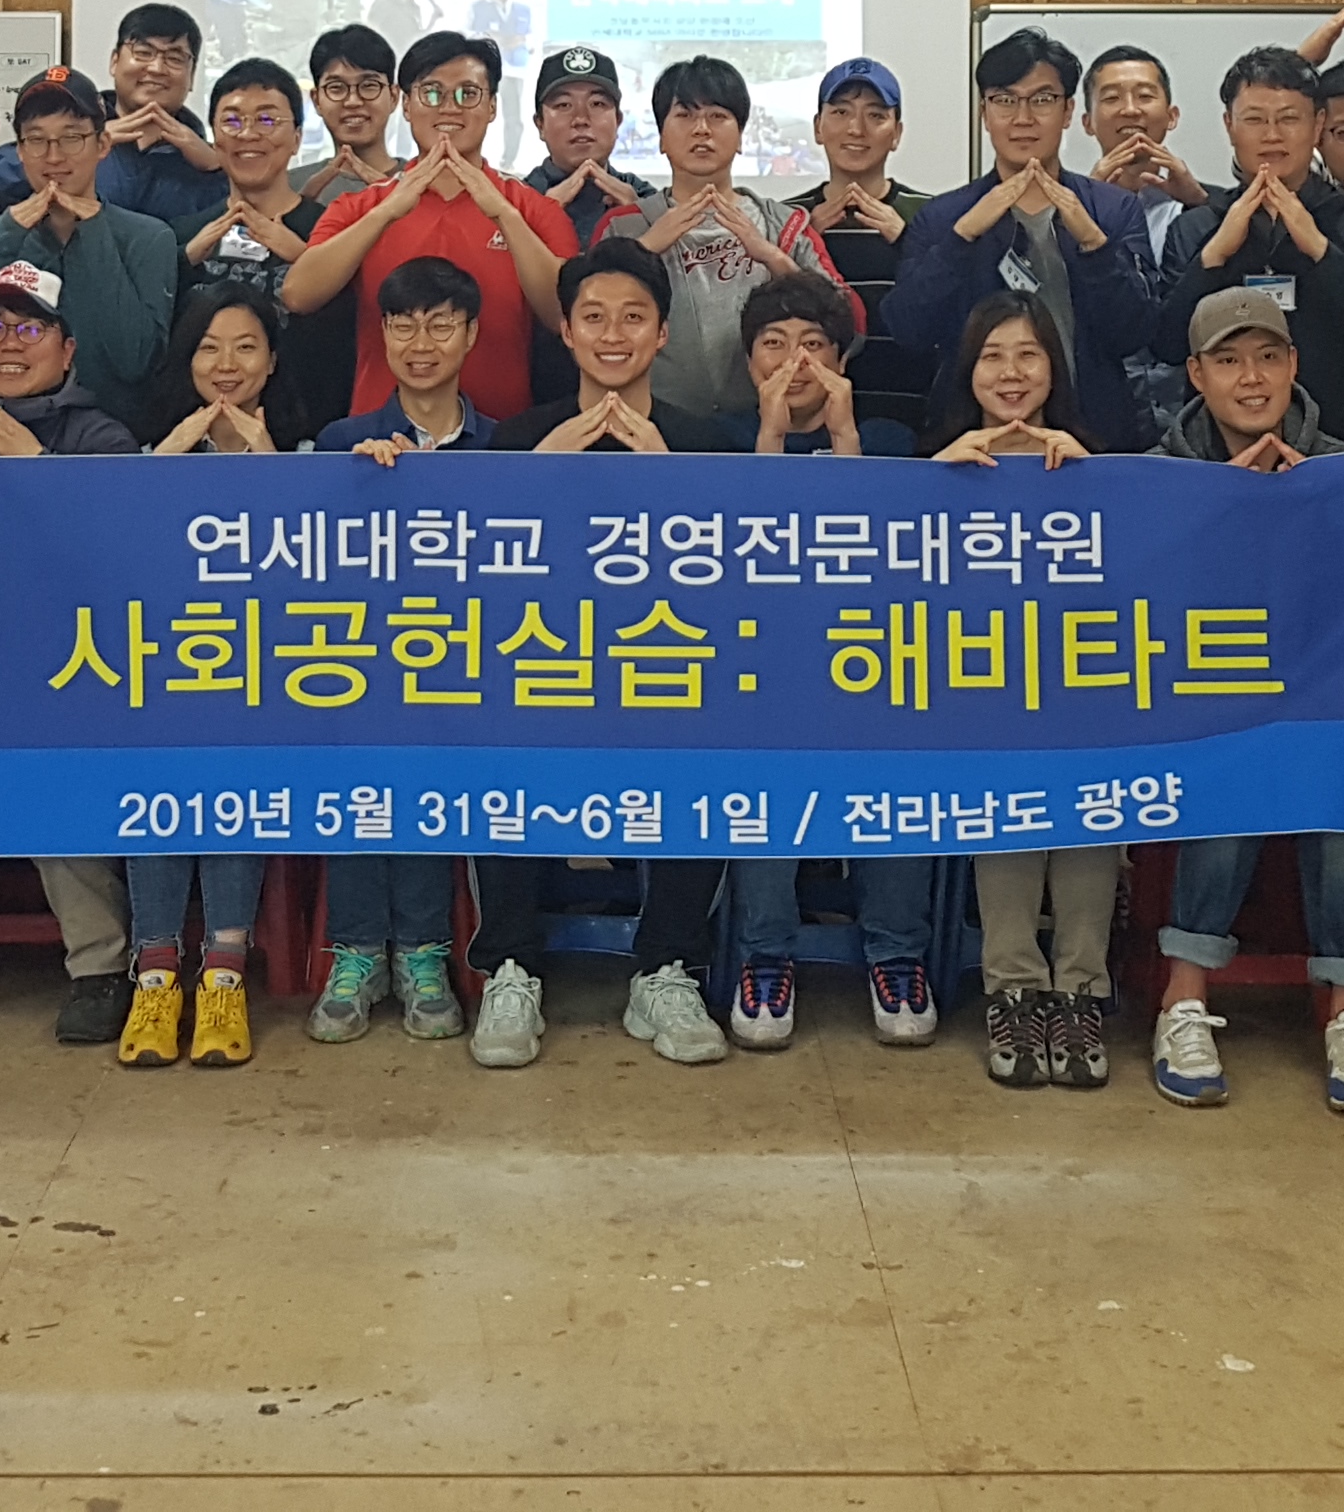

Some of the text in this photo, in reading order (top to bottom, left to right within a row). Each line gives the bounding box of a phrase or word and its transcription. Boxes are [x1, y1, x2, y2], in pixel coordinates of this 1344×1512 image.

[186, 508, 1105, 586] 연세대학교 경영전문대학원
[49, 596, 1285, 711] 사회공헌실습: 해비타트
[117, 787, 291, 838] 2019년
[314, 785, 394, 839] 5월
[691, 790, 770, 844] 1일
[792, 790, 819, 845] /
[842, 790, 1055, 844] 전라남도
[1074, 772, 1184, 829] 광양
